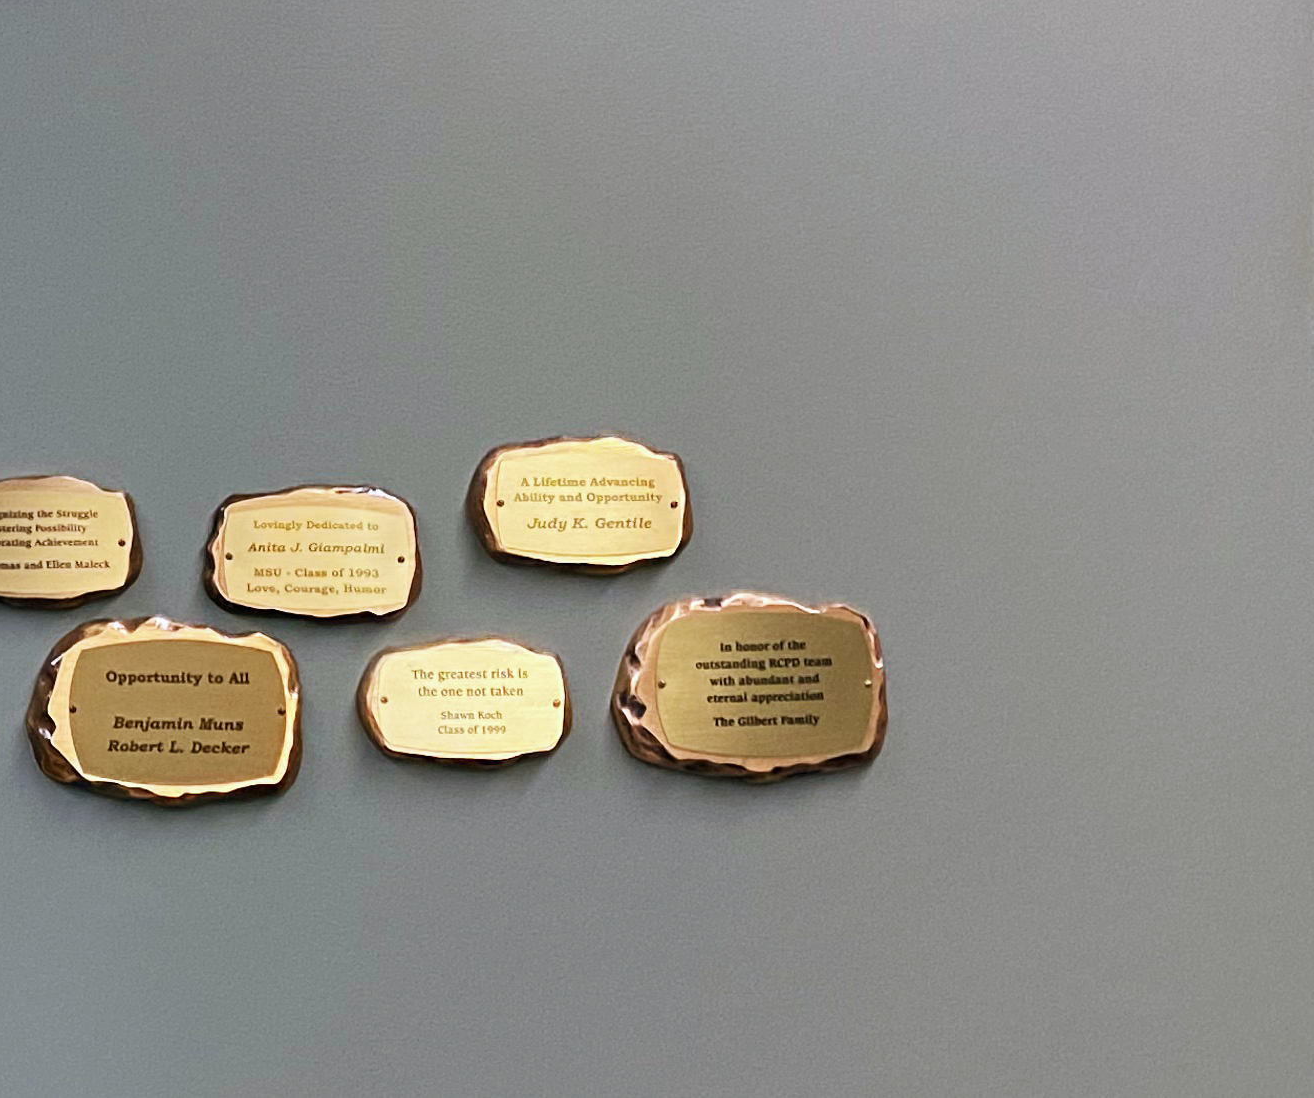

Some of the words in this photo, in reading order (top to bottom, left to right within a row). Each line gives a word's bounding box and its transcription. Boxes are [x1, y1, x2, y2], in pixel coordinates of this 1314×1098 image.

[520, 477, 530, 487] A
[533, 476, 587, 487] Lifetime
[589, 476, 656, 490] Advancing
[513, 492, 556, 505] Ability
[558, 492, 583, 503] and
[586, 492, 664, 505] Opportunity
[253, 519, 303, 532] Lovingly
[306, 520, 364, 531] Dedicated
[367, 522, 379, 531] to
[526, 517, 568, 533] Judy
[571, 517, 589, 529] K.
[594, 517, 652, 529] Gentile
[247, 541, 286, 553] Anita
[289, 542, 303, 553] J.
[253, 567, 282, 578] MSU
[294, 567, 328, 578] Class
[331, 567, 345, 578] of
[348, 568, 380, 579] 1993
[246, 582, 281, 595] Love,
[343, 583, 387, 595] Humor
[719, 642, 733, 653] In
[735, 640, 771, 653] honor
[771, 639, 786, 652] of
[787, 639, 806, 651] the
[695, 657, 767, 672] outstanding
[768, 657, 801, 669] RCPD
[803, 657, 833, 668] team
[105, 670, 203, 687] Opportunity
[207, 672, 224, 685] to
[228, 671, 250, 685] All
[411, 668, 435, 680] The
[437, 670, 488, 683] greatest
[491, 667, 515, 679] risk
[518, 667, 529, 679] is
[709, 675, 736, 687] with
[738, 674, 795, 687] abundant
[797, 673, 820, 685] and
[418, 685, 438, 697] the
[440, 688, 464, 697] one
[466, 687, 487, 697] not
[489, 685, 524, 697] taken
[706, 691, 748, 704] eternal
[750, 691, 824, 705] appreciation
[440, 710, 475, 721] Shawn
[477, 710, 503, 720] Koch
[712, 716, 736, 728] The
[737, 715, 778, 727] Gilbert
[780, 714, 820, 727] Family
[112, 715, 195, 733] Benjamin
[198, 717, 244, 732] Muns
[437, 724, 465, 735] Class
[466, 724, 480, 735] of
[481, 725, 507, 735] 1999
[107, 739, 165, 753] Robert
[168, 739, 185, 754] L.
[189, 740, 251, 755] Decker
